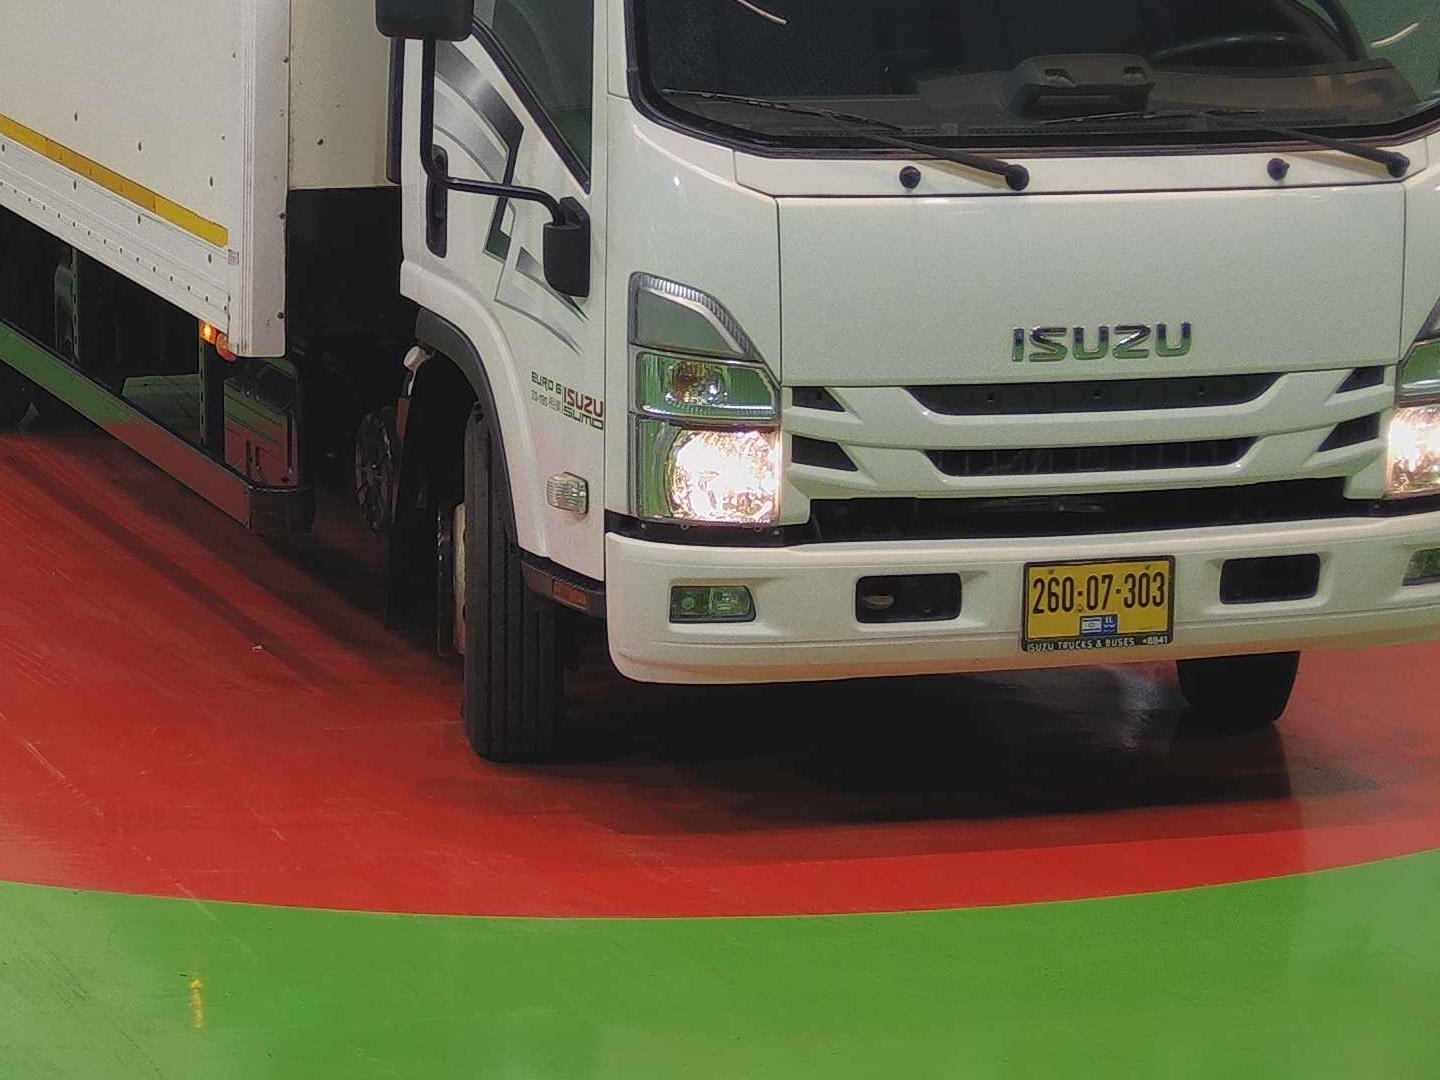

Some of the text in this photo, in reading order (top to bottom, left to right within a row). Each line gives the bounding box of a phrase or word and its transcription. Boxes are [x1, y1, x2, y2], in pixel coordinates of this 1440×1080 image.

[1012, 322, 1192, 362] ISUZU
[531, 370, 554, 392] EURO
[563, 386, 604, 418] ISUZU
[563, 405, 604, 431] SUMO
[1058, 639, 1093, 650] TRUCKS
[1105, 637, 1135, 648] BUSES
